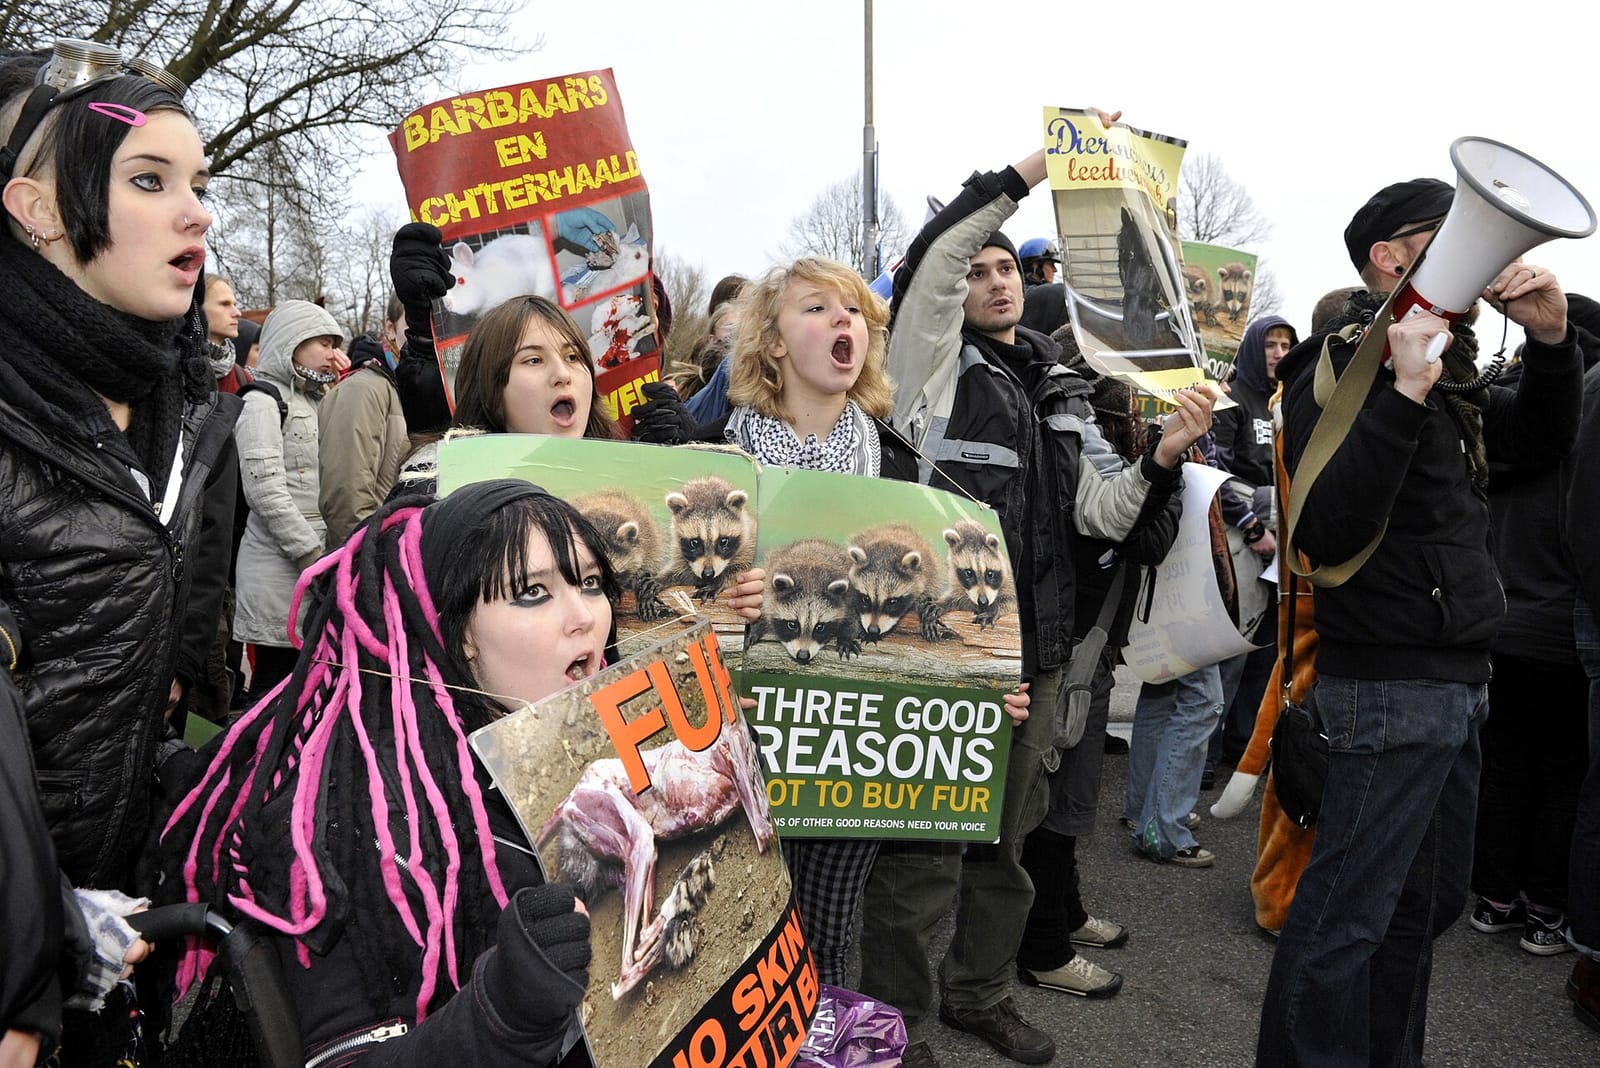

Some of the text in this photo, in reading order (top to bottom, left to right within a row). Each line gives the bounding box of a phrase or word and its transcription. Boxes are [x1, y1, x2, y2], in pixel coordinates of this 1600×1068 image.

[403, 75, 607, 152] BARBAARS
[494, 131, 547, 168] EN
[751, 686, 1002, 735] THREE GOOD
[754, 725, 995, 782] REASONS
[766, 778, 990, 813] OT TO BUY FUR
[787, 817, 801, 827] OF
[802, 817, 833, 828] OTHER
[835, 818, 862, 828] GOOD
[863, 819, 905, 829] REASONS
[907, 820, 932, 830] NEED
[934, 821, 958, 831] YOUR
[960, 822, 986, 832] VOICE
[732, 909, 805, 1032] SKIN
